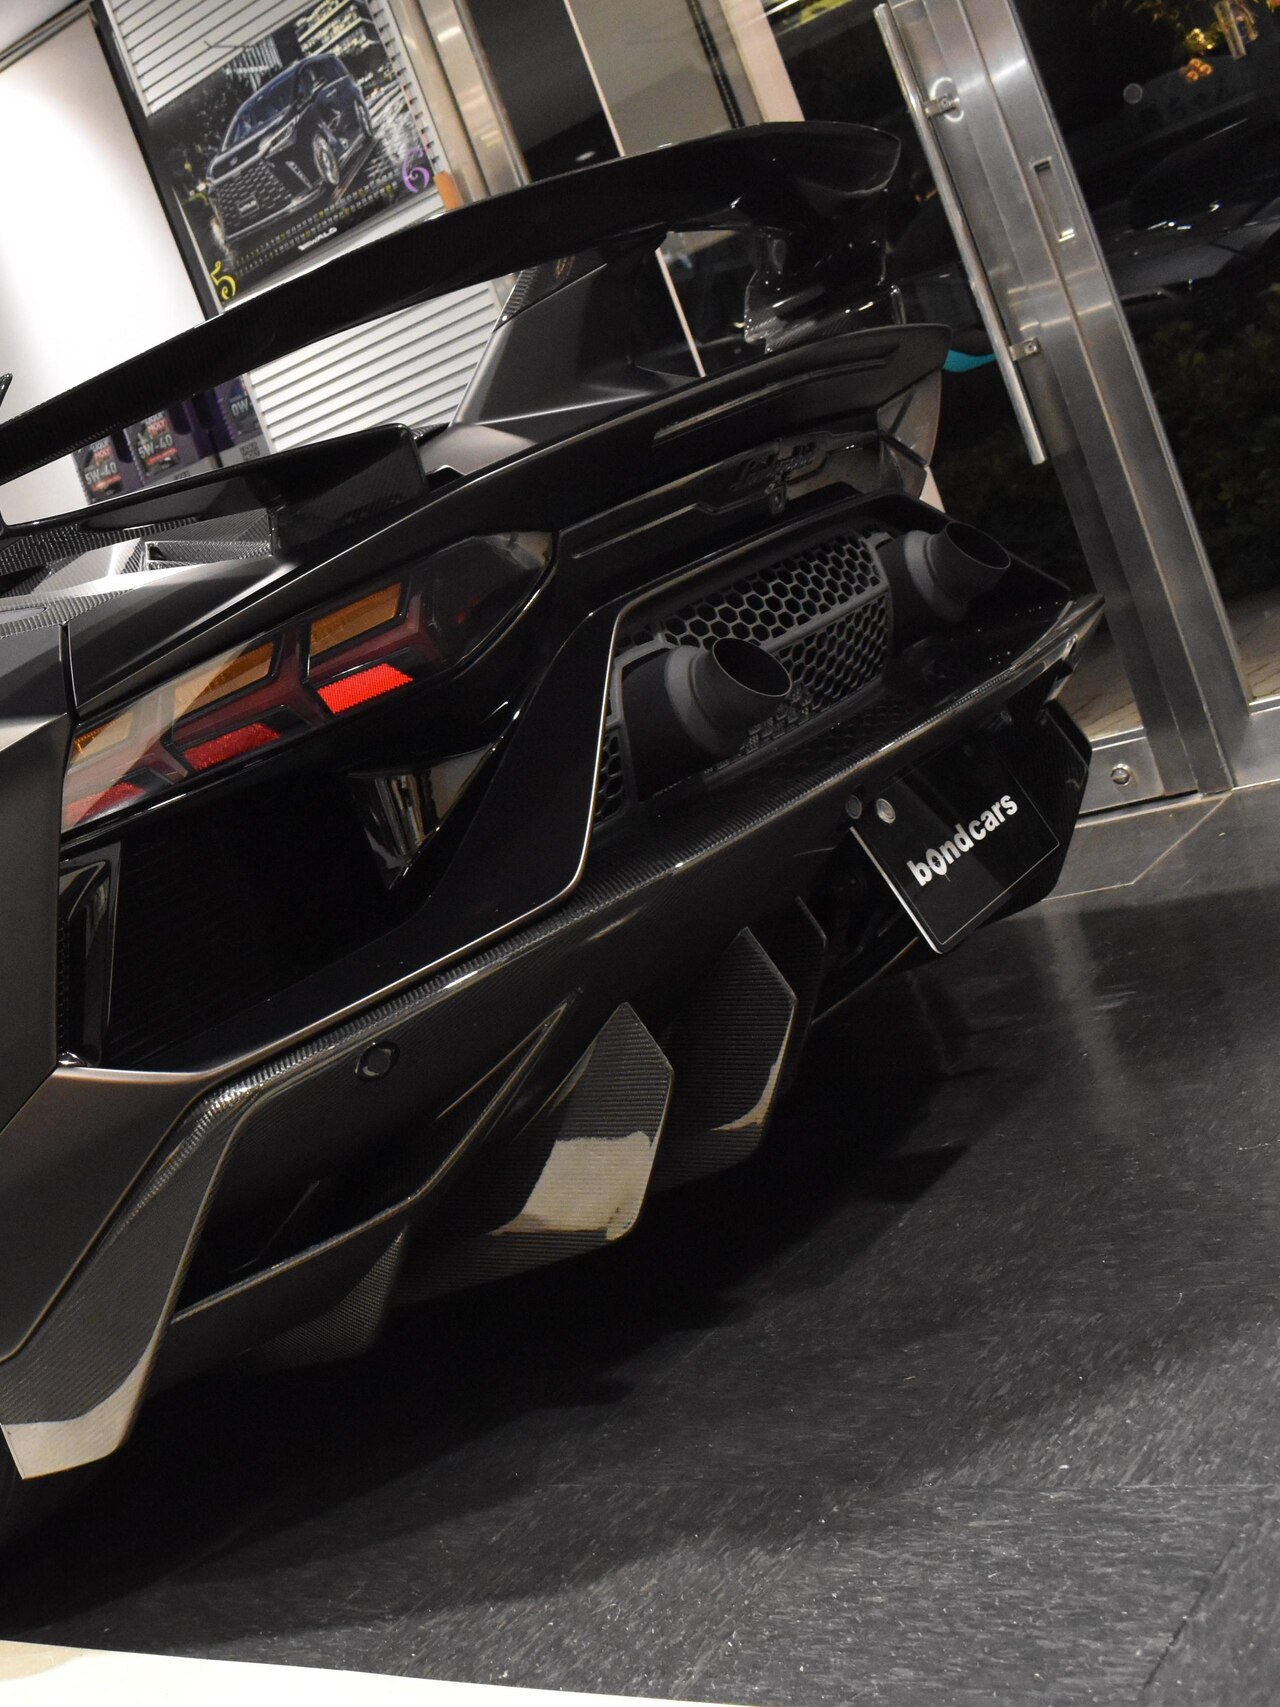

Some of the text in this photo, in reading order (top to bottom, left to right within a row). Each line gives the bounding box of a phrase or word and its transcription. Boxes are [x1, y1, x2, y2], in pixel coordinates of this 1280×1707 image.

[402, 146, 430, 193] 6
[210, 260, 236, 300] 5
[138, 434, 173, 459] 5W-40
[85, 461, 117, 485] 5W-40
